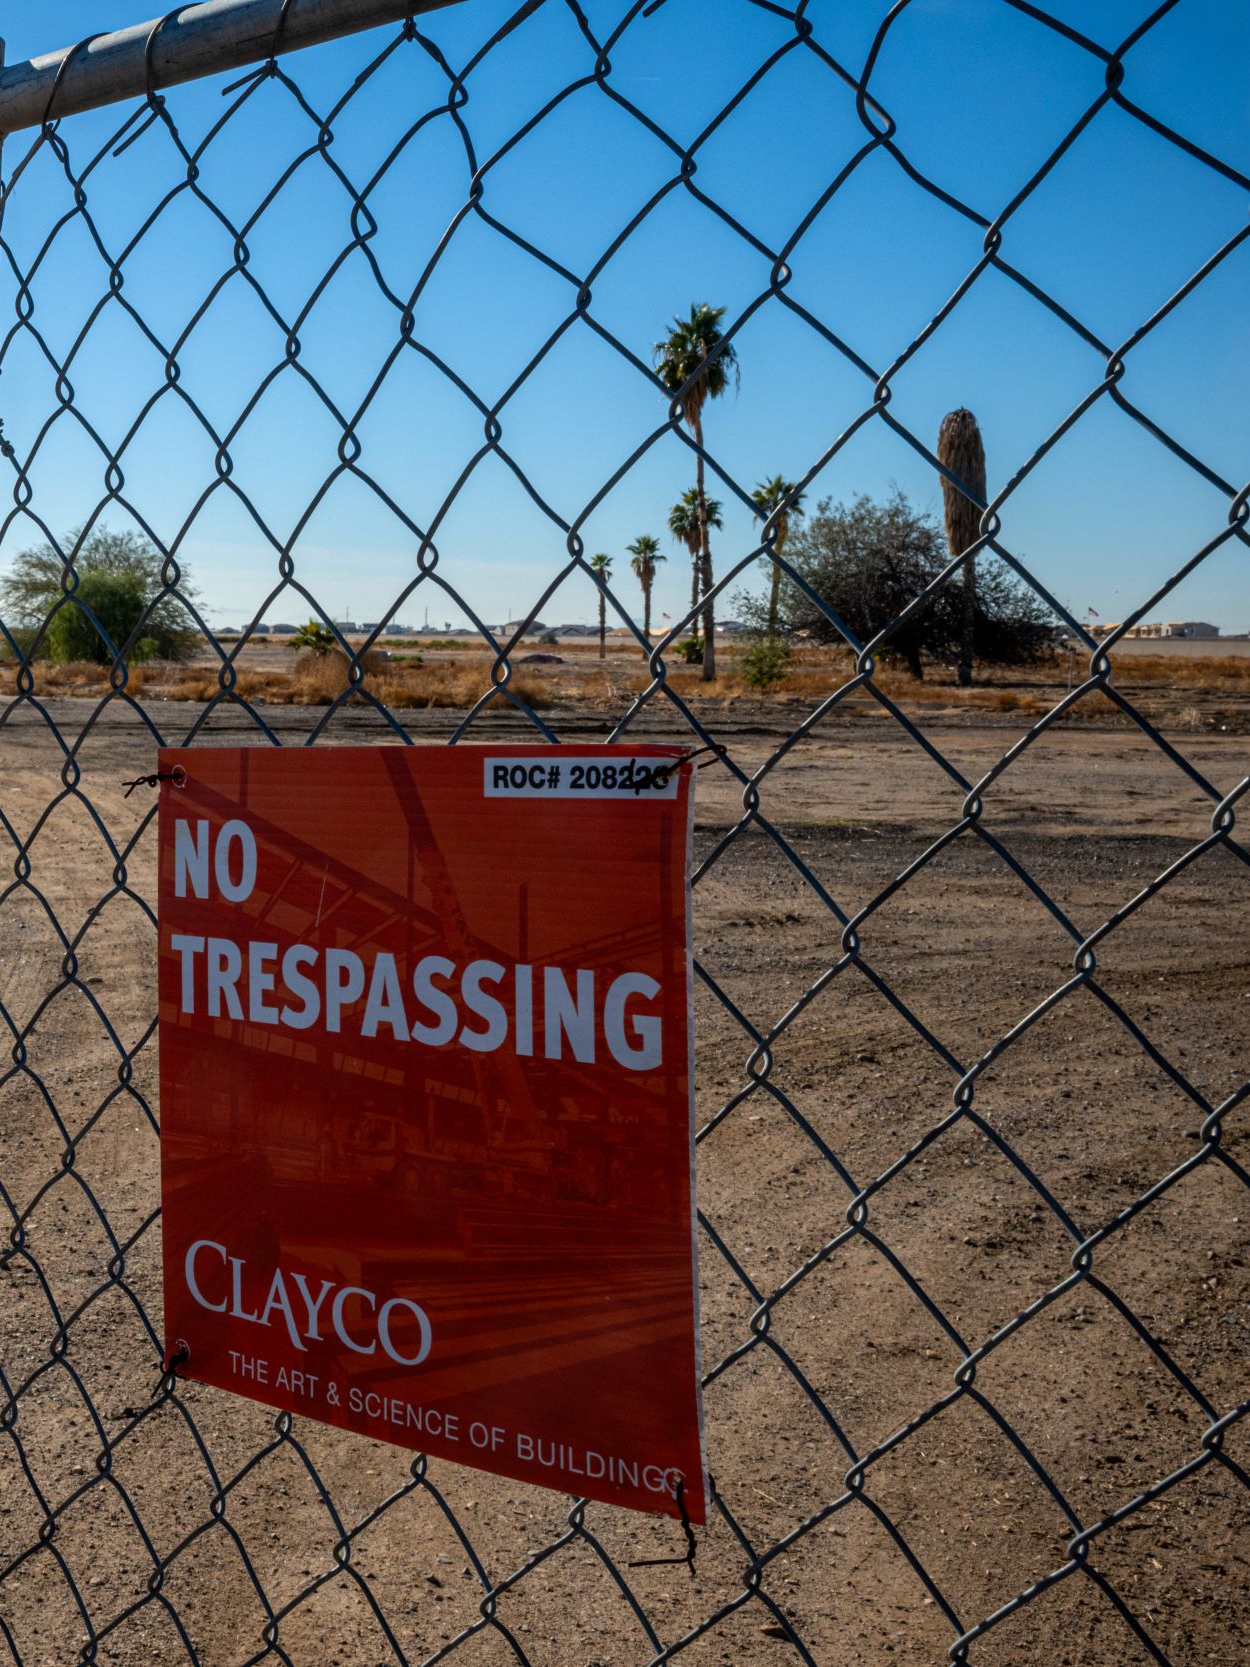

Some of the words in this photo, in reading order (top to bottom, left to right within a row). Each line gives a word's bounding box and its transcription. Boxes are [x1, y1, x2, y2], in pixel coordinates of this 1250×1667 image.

[493, 765, 560, 789] ROC#
[174, 819, 258, 903] NO
[171, 934, 663, 1071] TRESPASSING
[184, 1239, 432, 1366] CLAYCO
[228, 1350, 269, 1384] THE
[275, 1366, 319, 1399] ART
[326, 1382, 341, 1407] &
[349, 1387, 460, 1441] SCIENCE
[469, 1421, 506, 1452] OF
